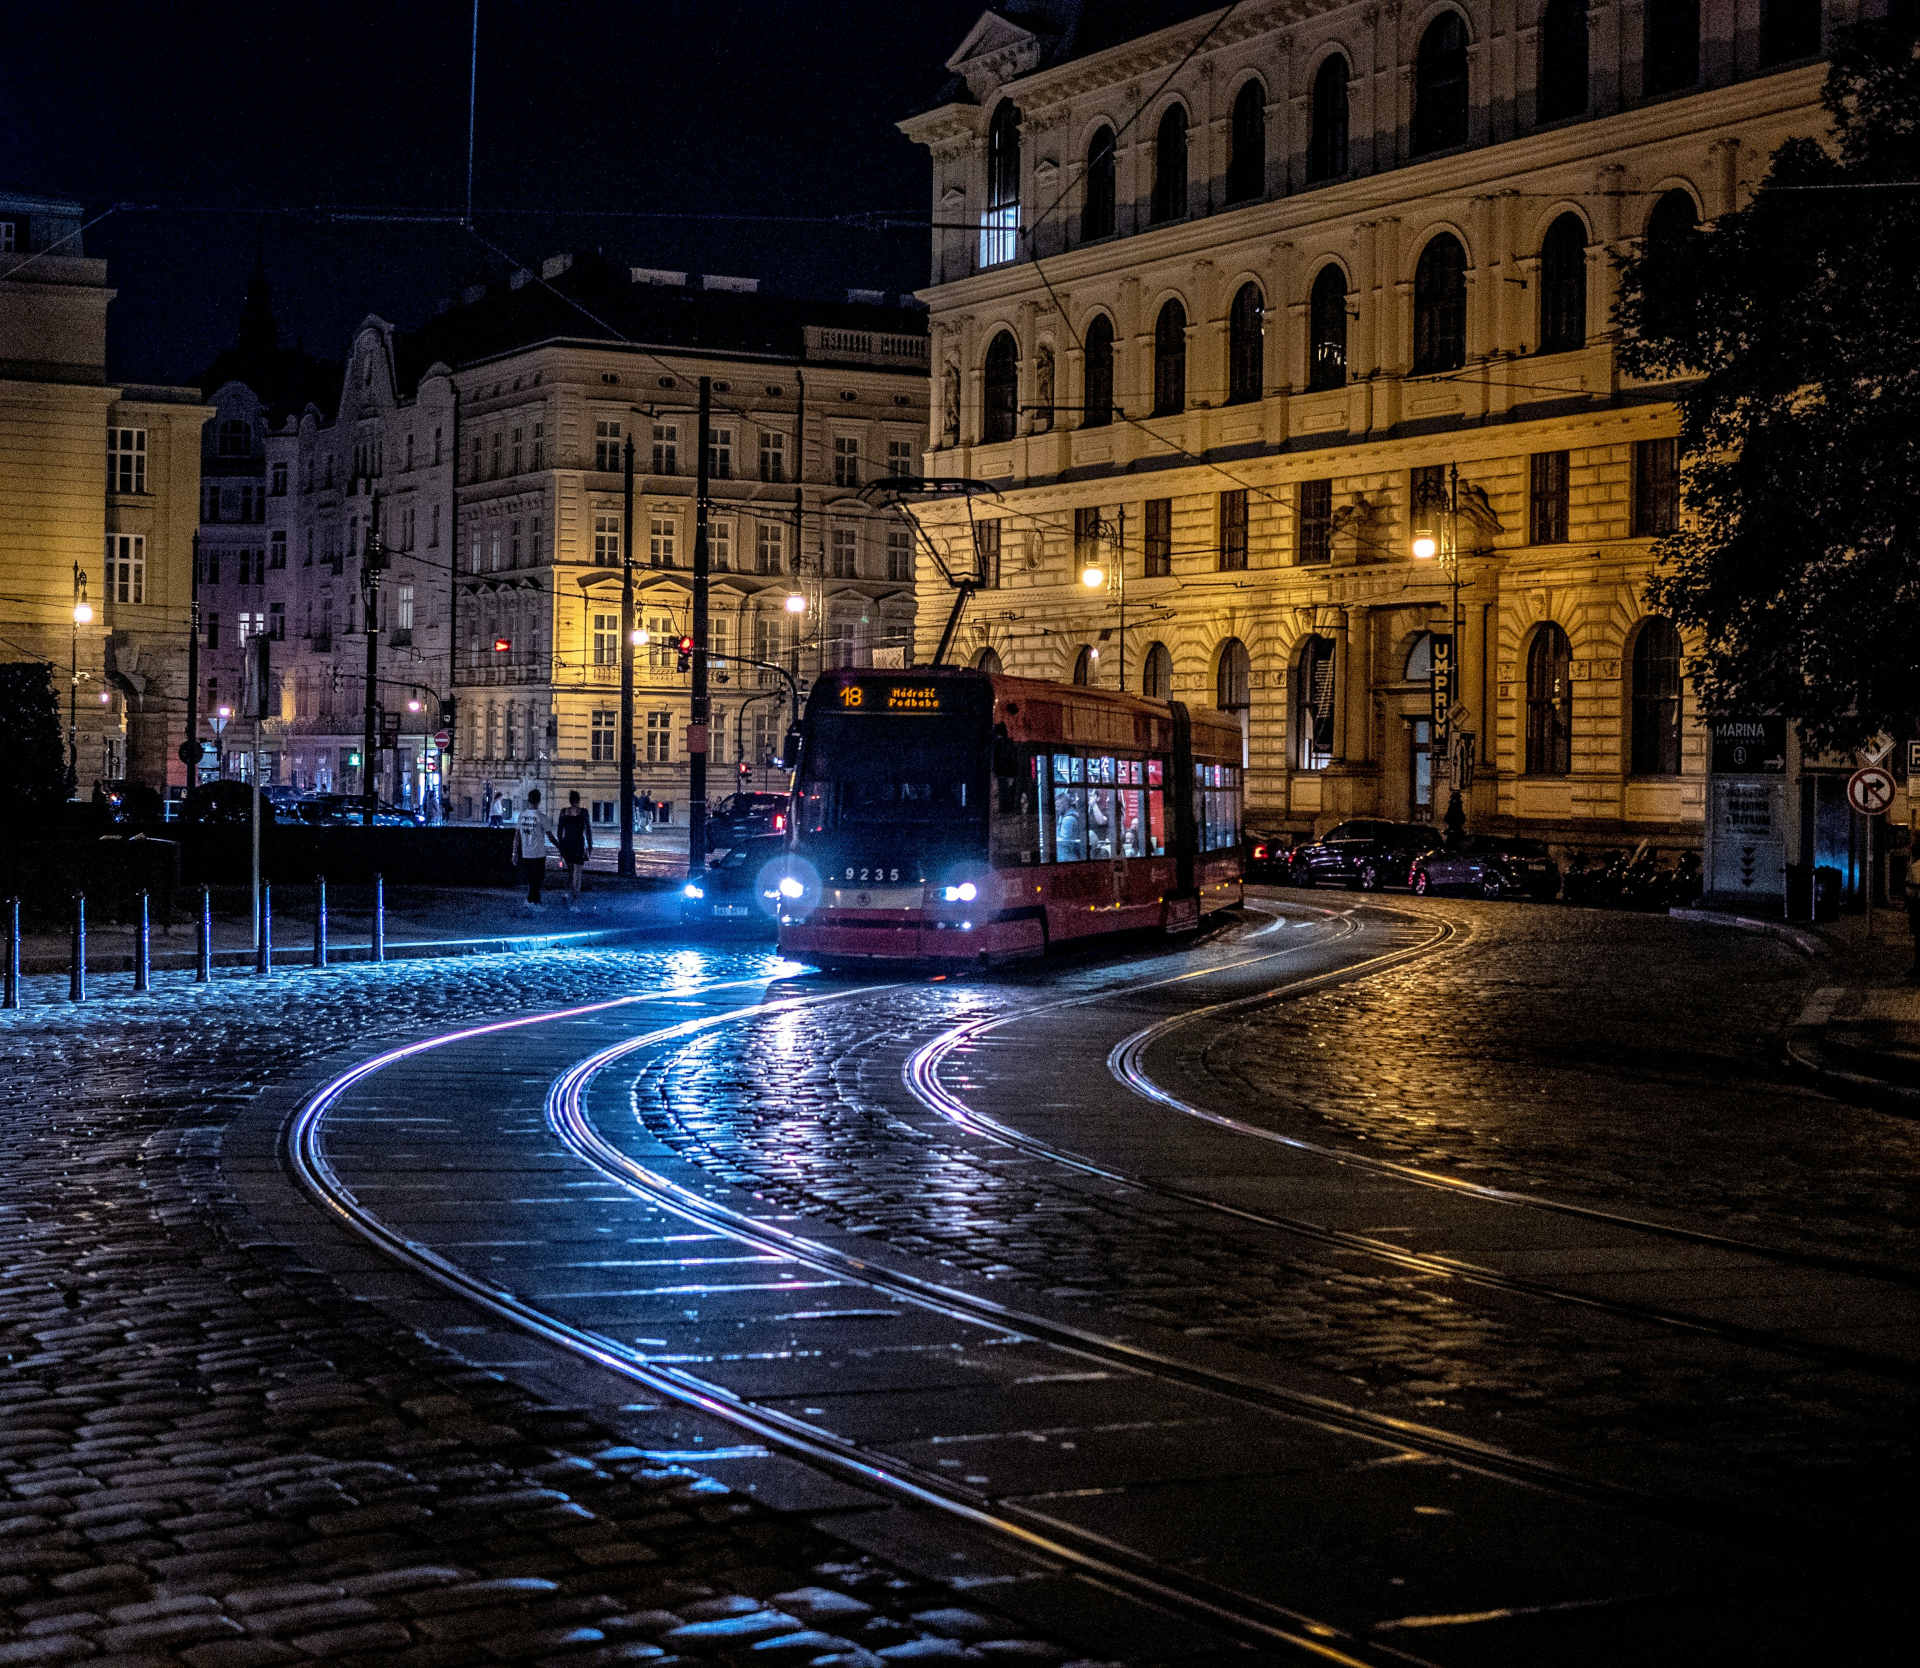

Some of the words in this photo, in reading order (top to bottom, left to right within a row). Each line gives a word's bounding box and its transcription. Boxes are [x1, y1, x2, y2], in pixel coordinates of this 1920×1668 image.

[840, 686, 863, 707] 18
[1434, 643, 1449, 739] UMPRUM
[1716, 722, 1766, 737] MARINA
[845, 867, 899, 881] 9235
